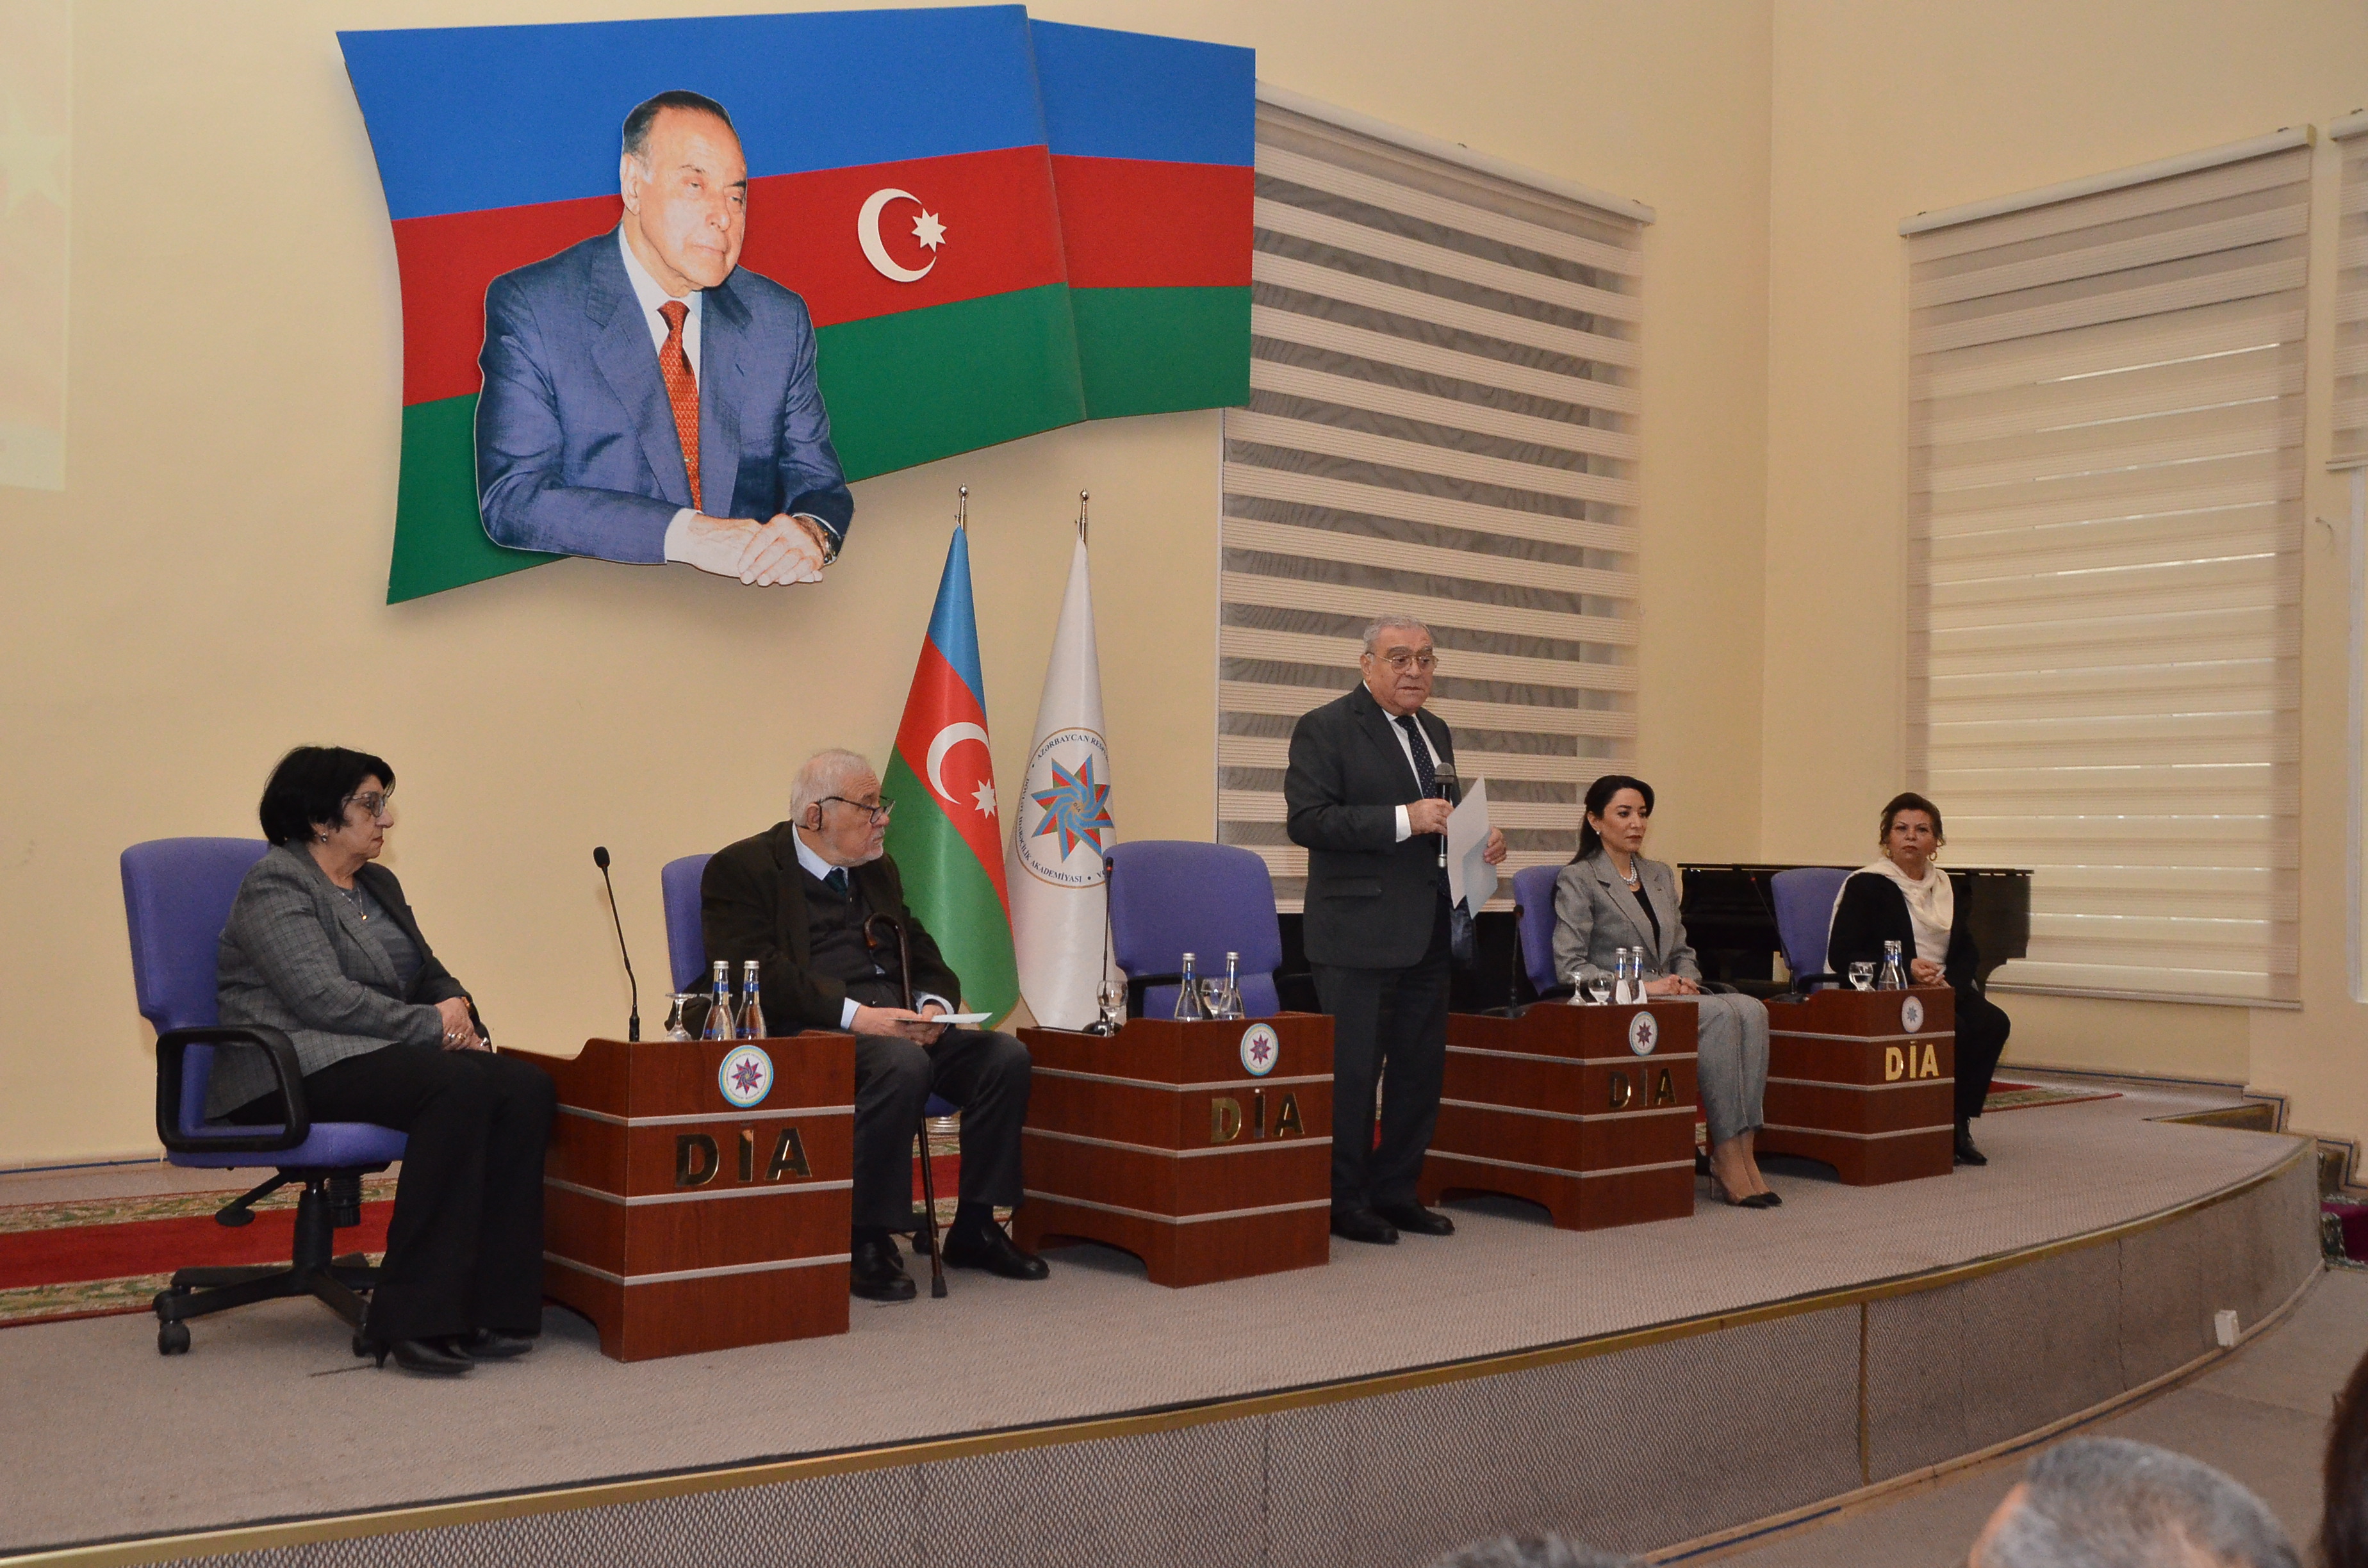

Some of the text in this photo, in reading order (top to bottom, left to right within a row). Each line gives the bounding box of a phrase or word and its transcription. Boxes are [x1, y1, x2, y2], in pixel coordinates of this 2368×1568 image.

[1037, 734, 1089, 760] AZƏRBAYCAN
[1030, 860, 1082, 883] AKADEMİYASI
[1885, 1040, 1939, 1081] DİA
[1211, 1089, 1304, 1143] DİA
[676, 1122, 812, 1186] DİA
